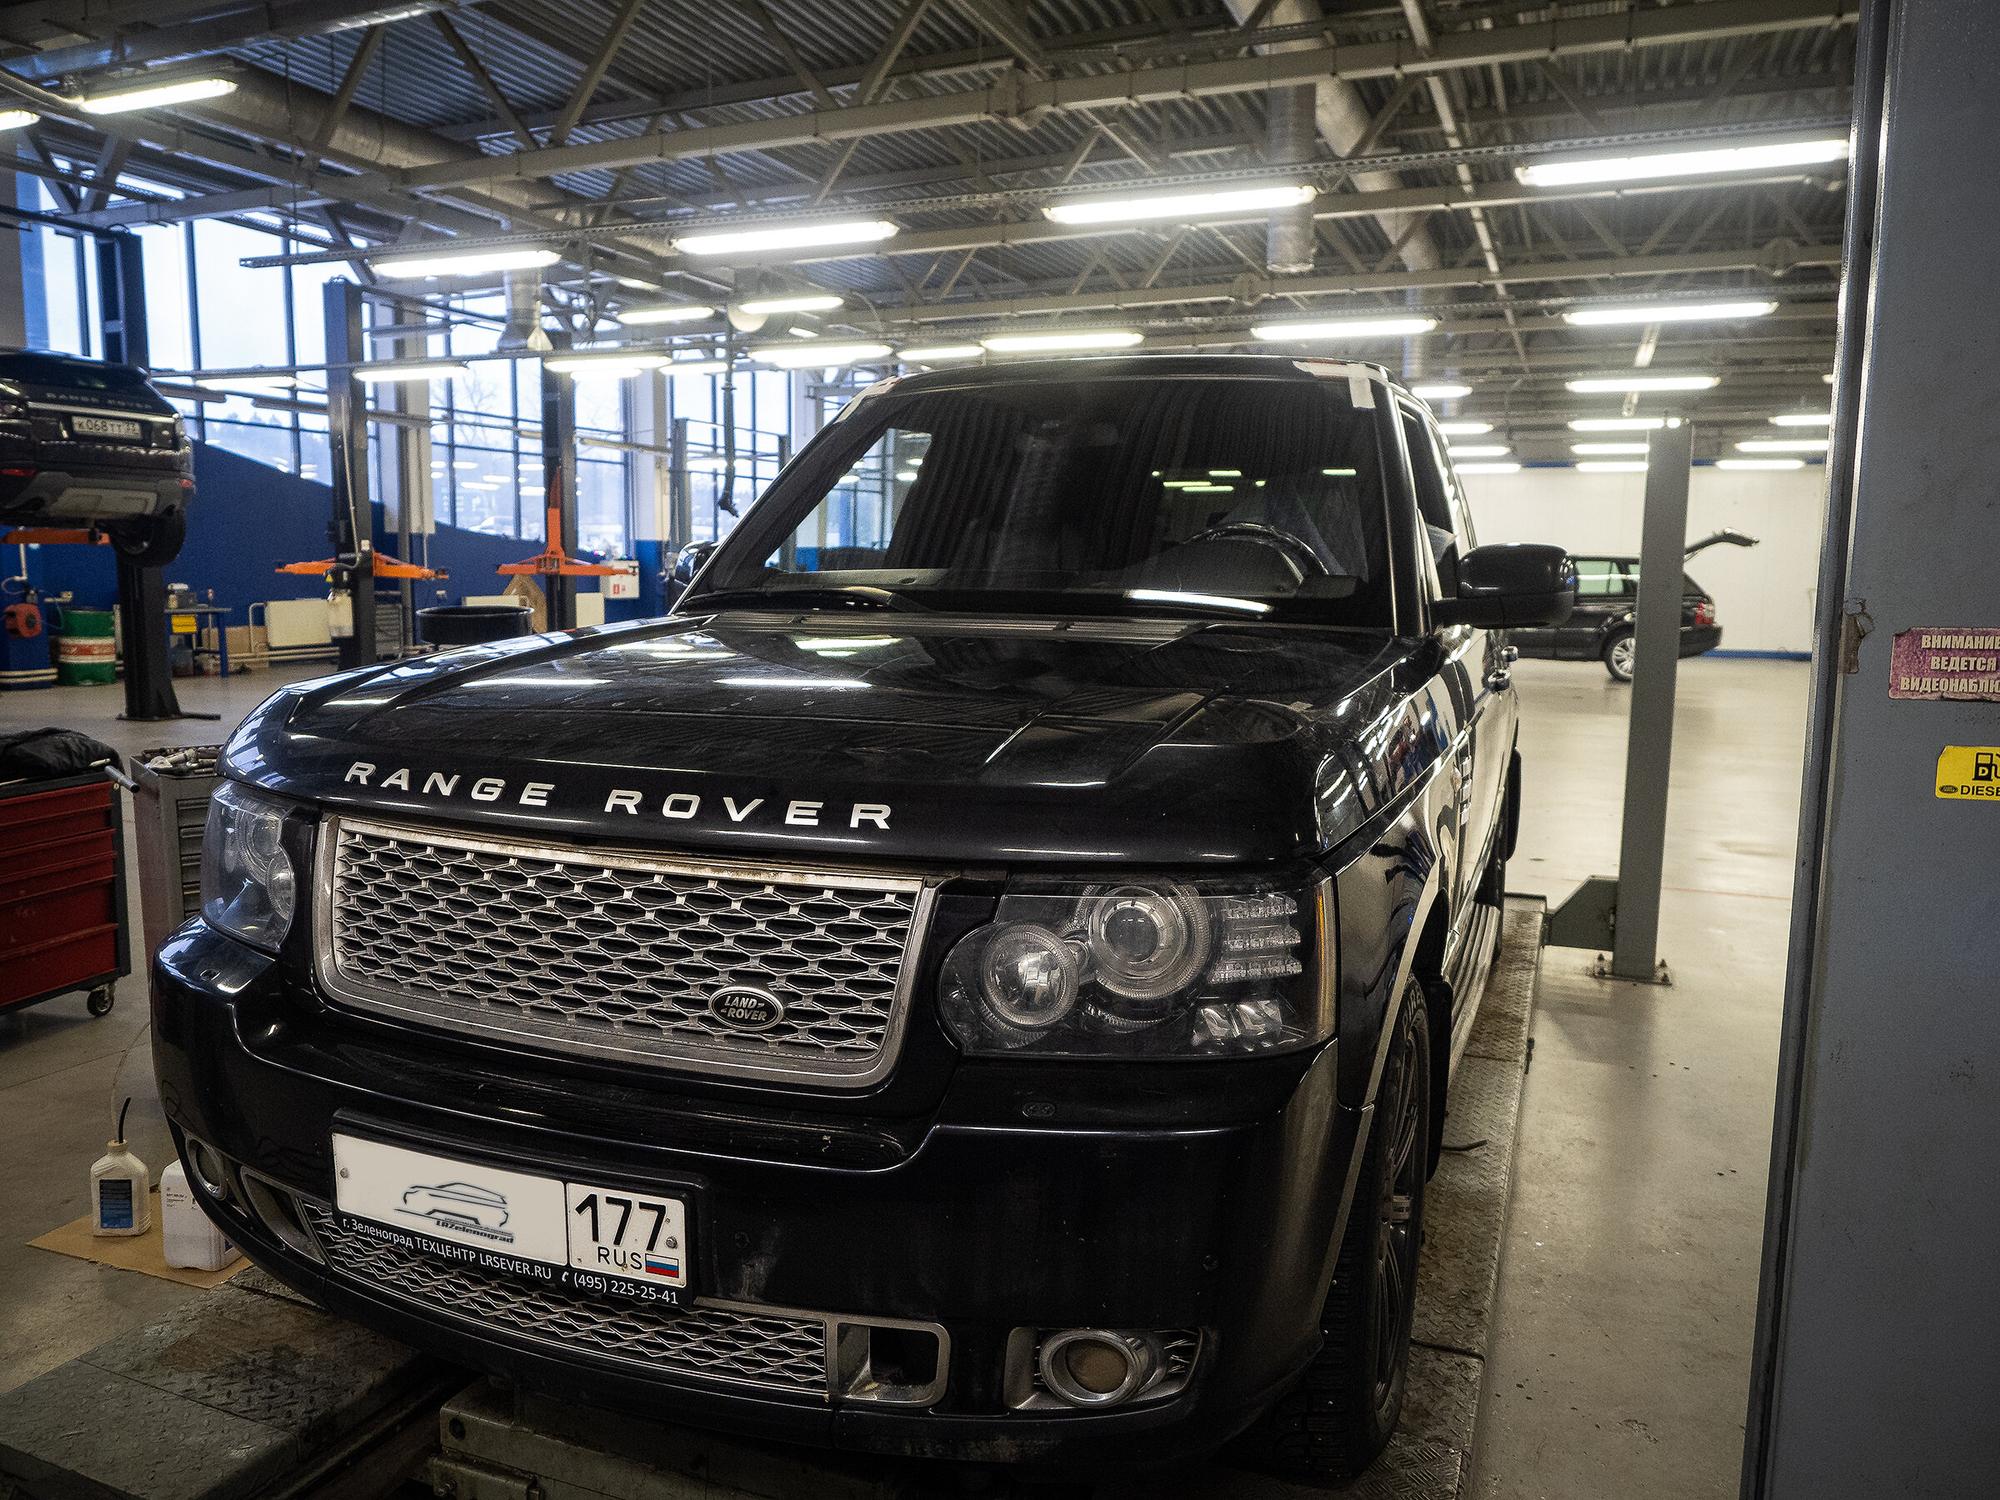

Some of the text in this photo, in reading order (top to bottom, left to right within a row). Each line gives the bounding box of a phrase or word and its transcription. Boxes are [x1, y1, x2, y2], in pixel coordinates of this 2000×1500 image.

[1930, 656, 1997, 672] ВЕДЕТСЯ
[1978, 766, 1989, 777] D
[344, 761, 892, 830] RANGE ROVER
[724, 996, 757, 1008] LAND
[727, 1008, 767, 1021] ROVER
[575, 1194, 666, 1252] 177
[342, 1218, 679, 1305] г. Зеленоград ТЕХЦЕНТР LRSEVER.RU (495) 225-25-41
[597, 1246, 643, 1270] RUS
